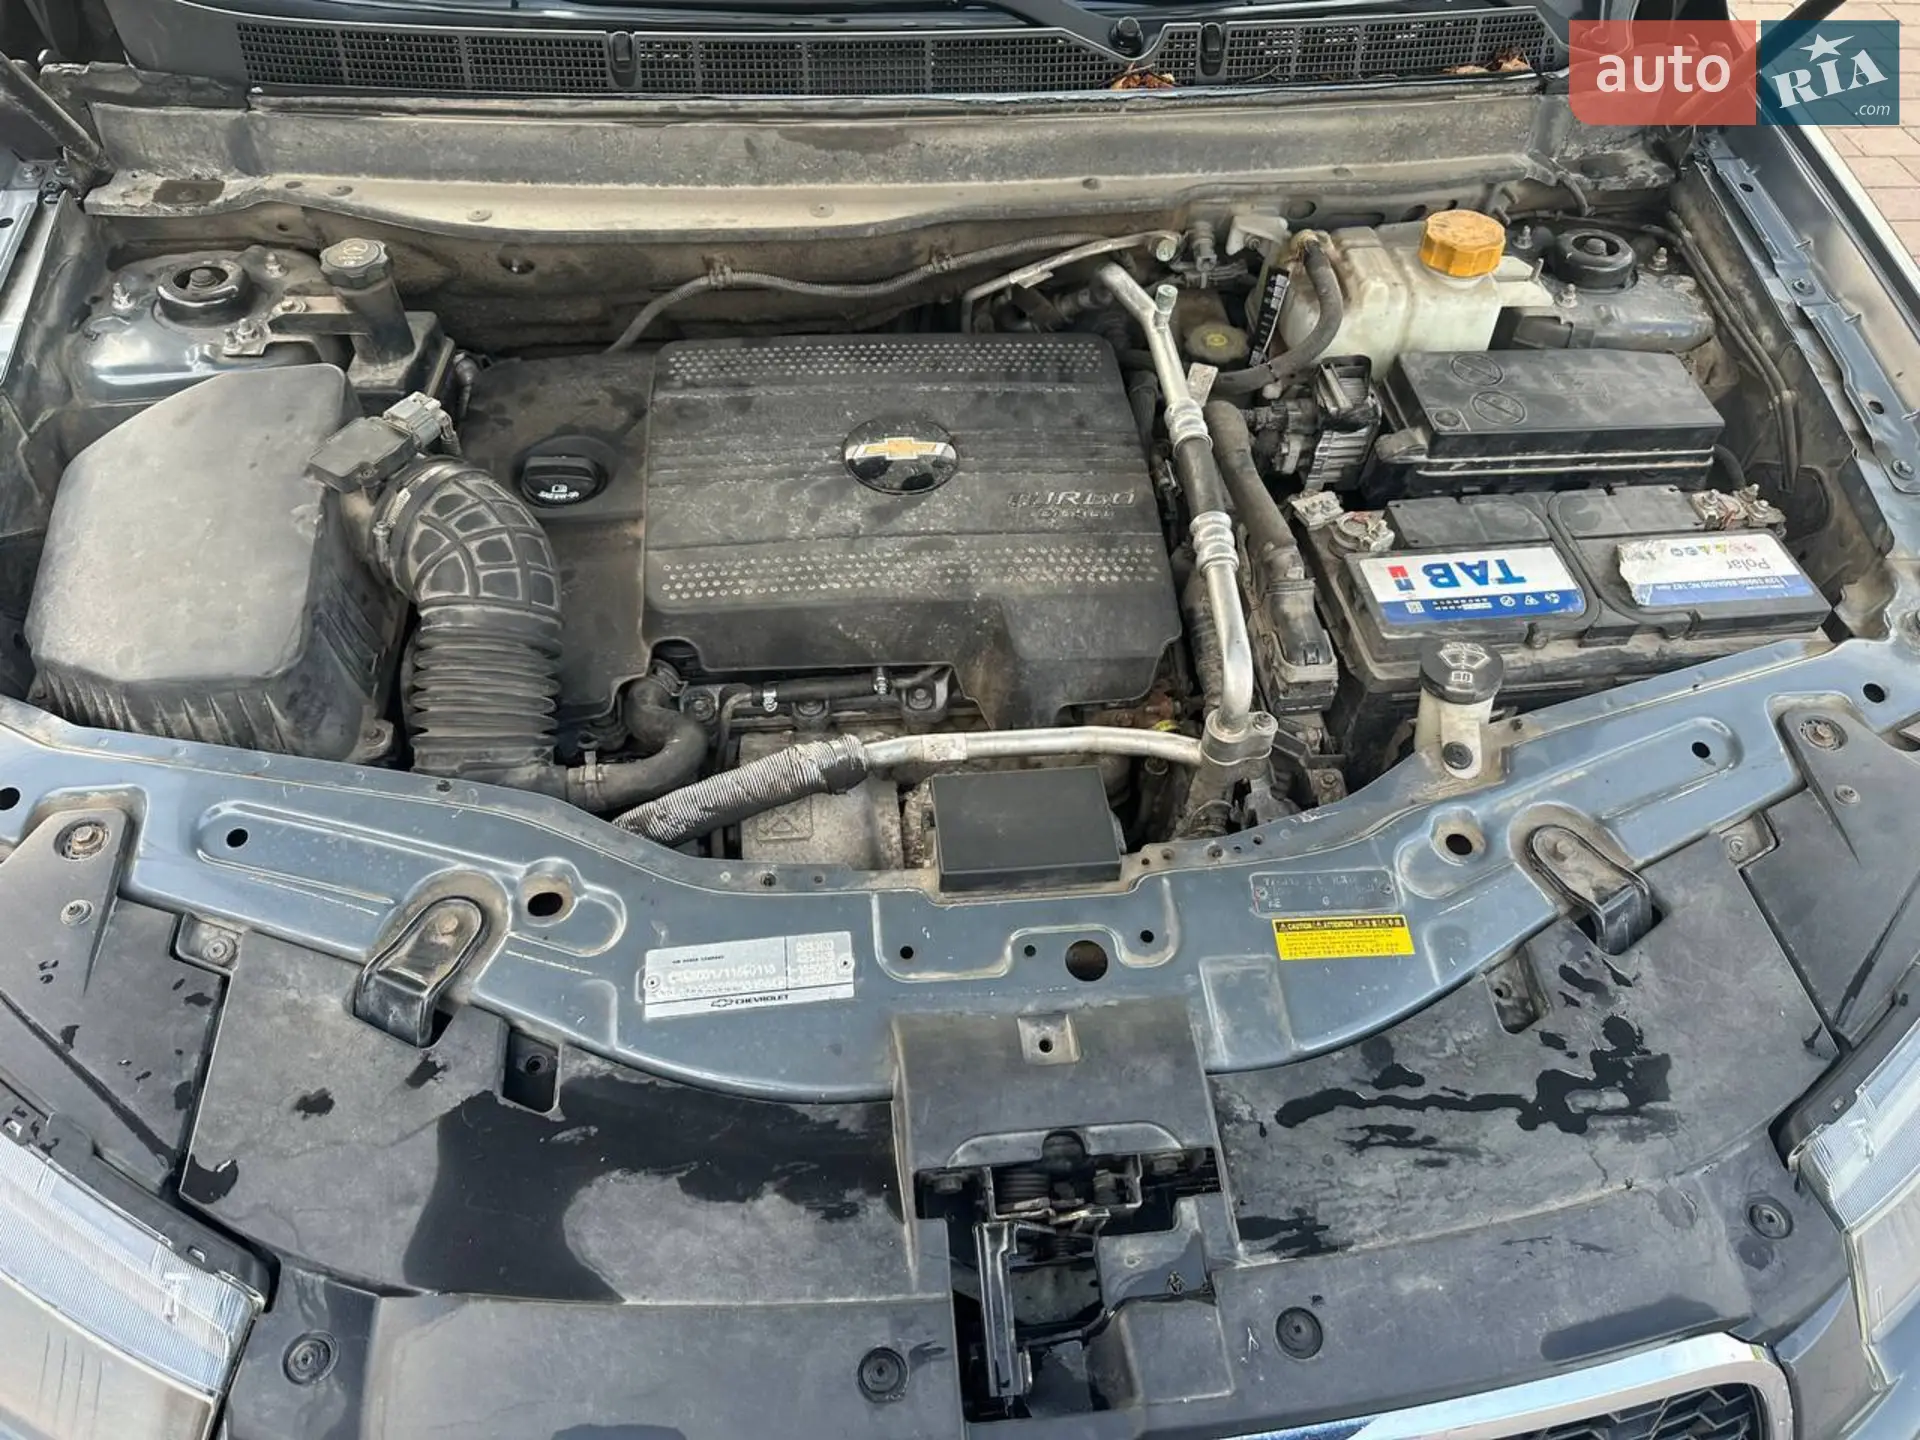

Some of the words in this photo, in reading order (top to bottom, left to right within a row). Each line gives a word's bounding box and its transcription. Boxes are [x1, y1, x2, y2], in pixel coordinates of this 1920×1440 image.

[1727, 557, 1771, 571] Polar
[1422, 558, 1527, 588] TAB
[734, 993, 790, 1006] CHEVROLET
